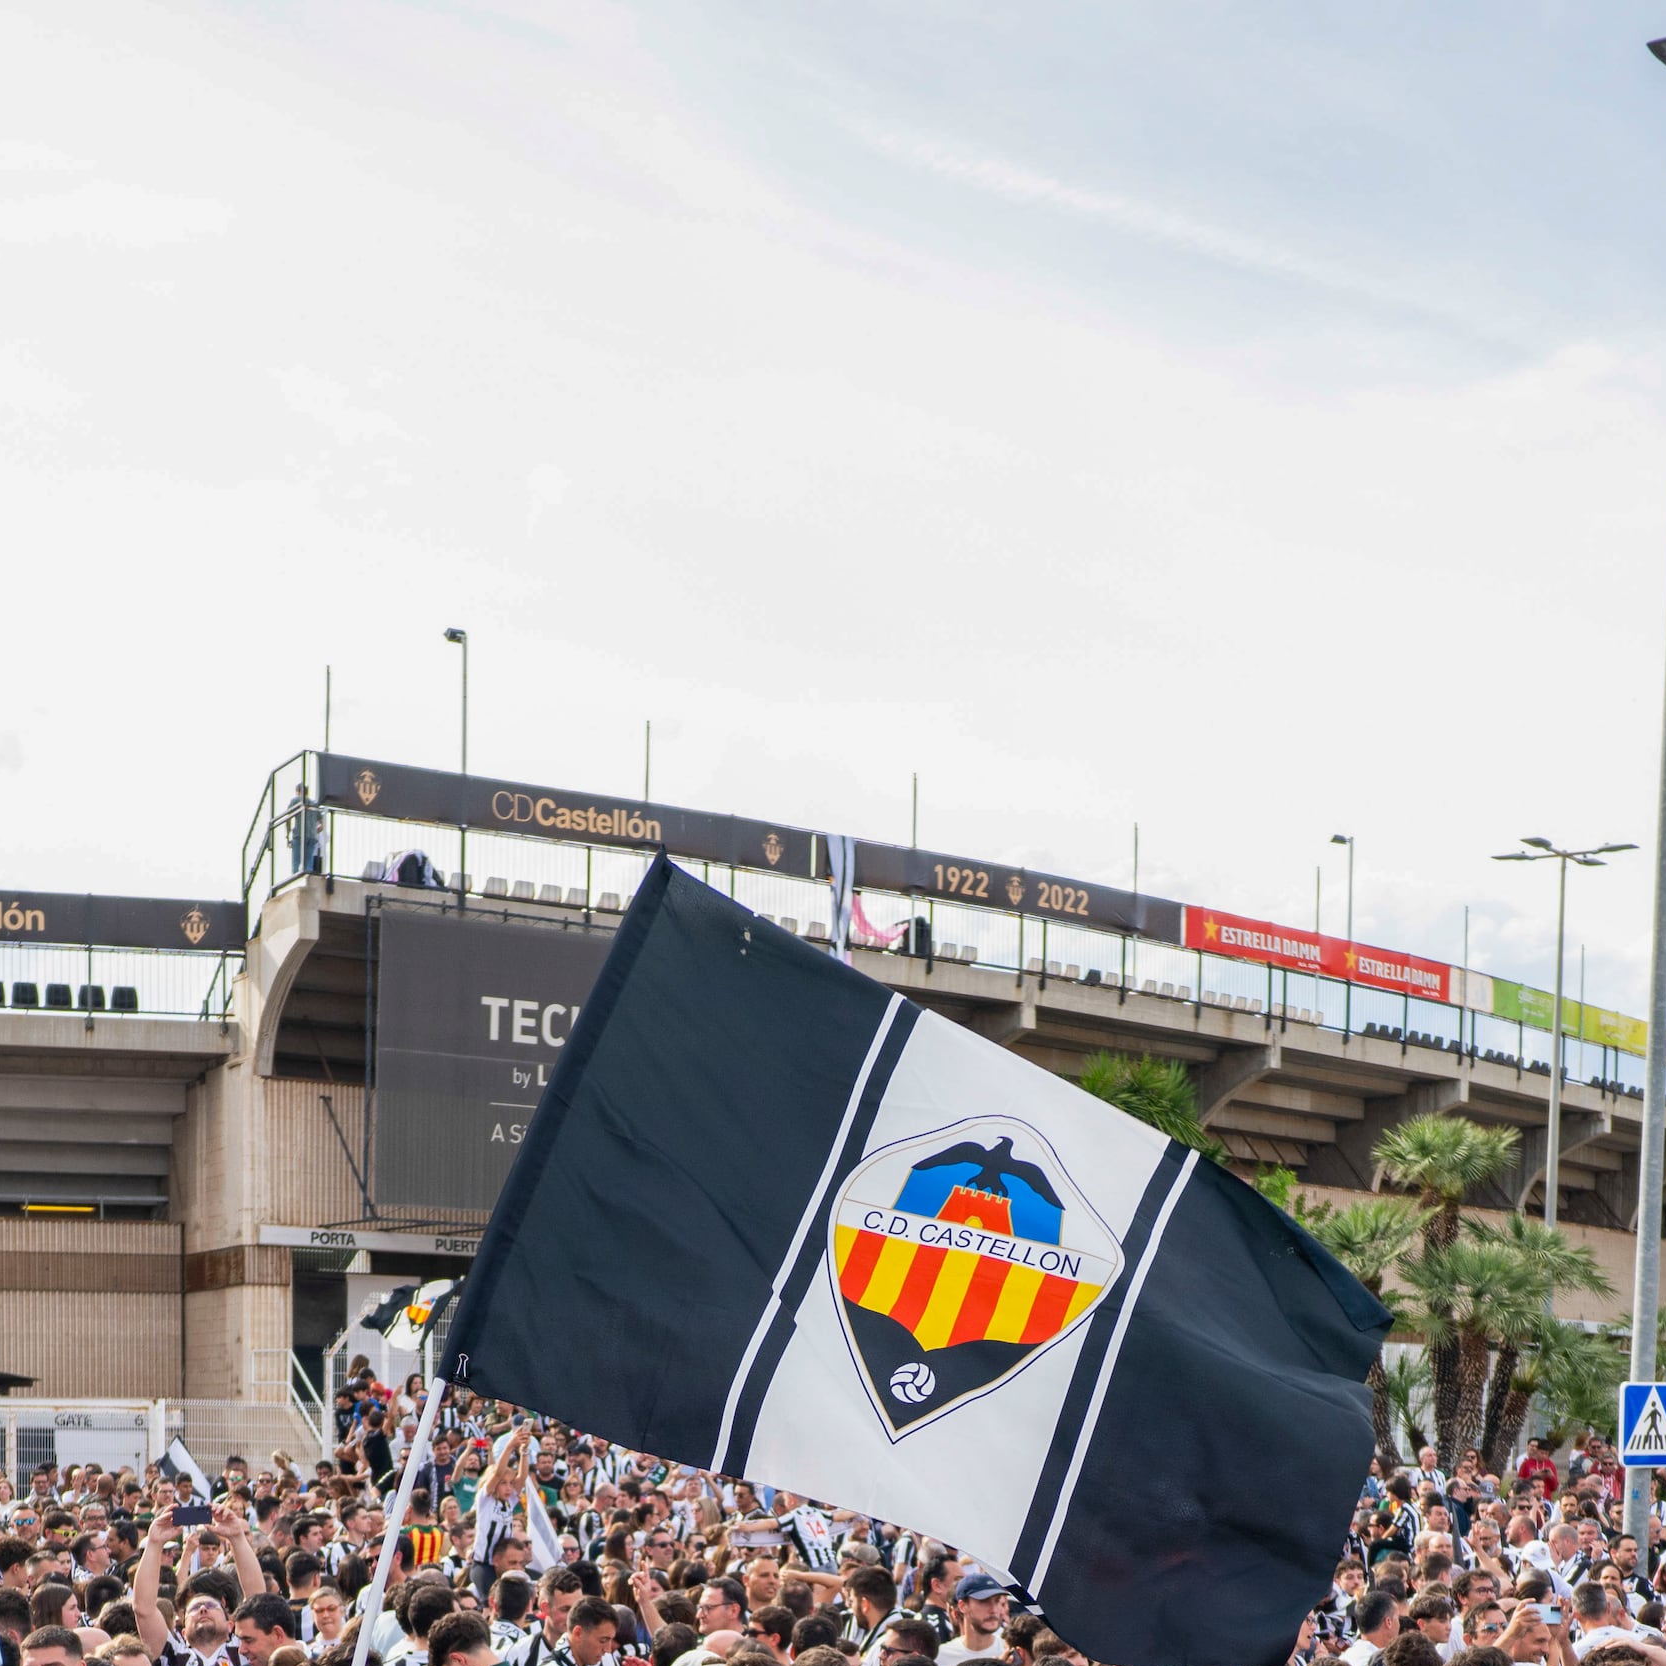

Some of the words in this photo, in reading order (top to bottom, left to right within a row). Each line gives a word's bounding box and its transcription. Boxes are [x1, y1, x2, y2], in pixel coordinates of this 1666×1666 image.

[934, 863, 989, 898] 1922
[1038, 881, 1090, 916] 2022
[1220, 925, 1282, 954] ESTRELLA
[1282, 938, 1321, 962] DAMM
[1359, 956, 1411, 983] ESTRELLA
[512, 1067, 532, 1089] by
[310, 1231, 357, 1247] PORTA
[863, 1210, 910, 1238] C.D.
[919, 1223, 1082, 1278] CASTELLON
[55, 1414, 94, 1428] GATE
[135, 1414, 144, 1426] 6
